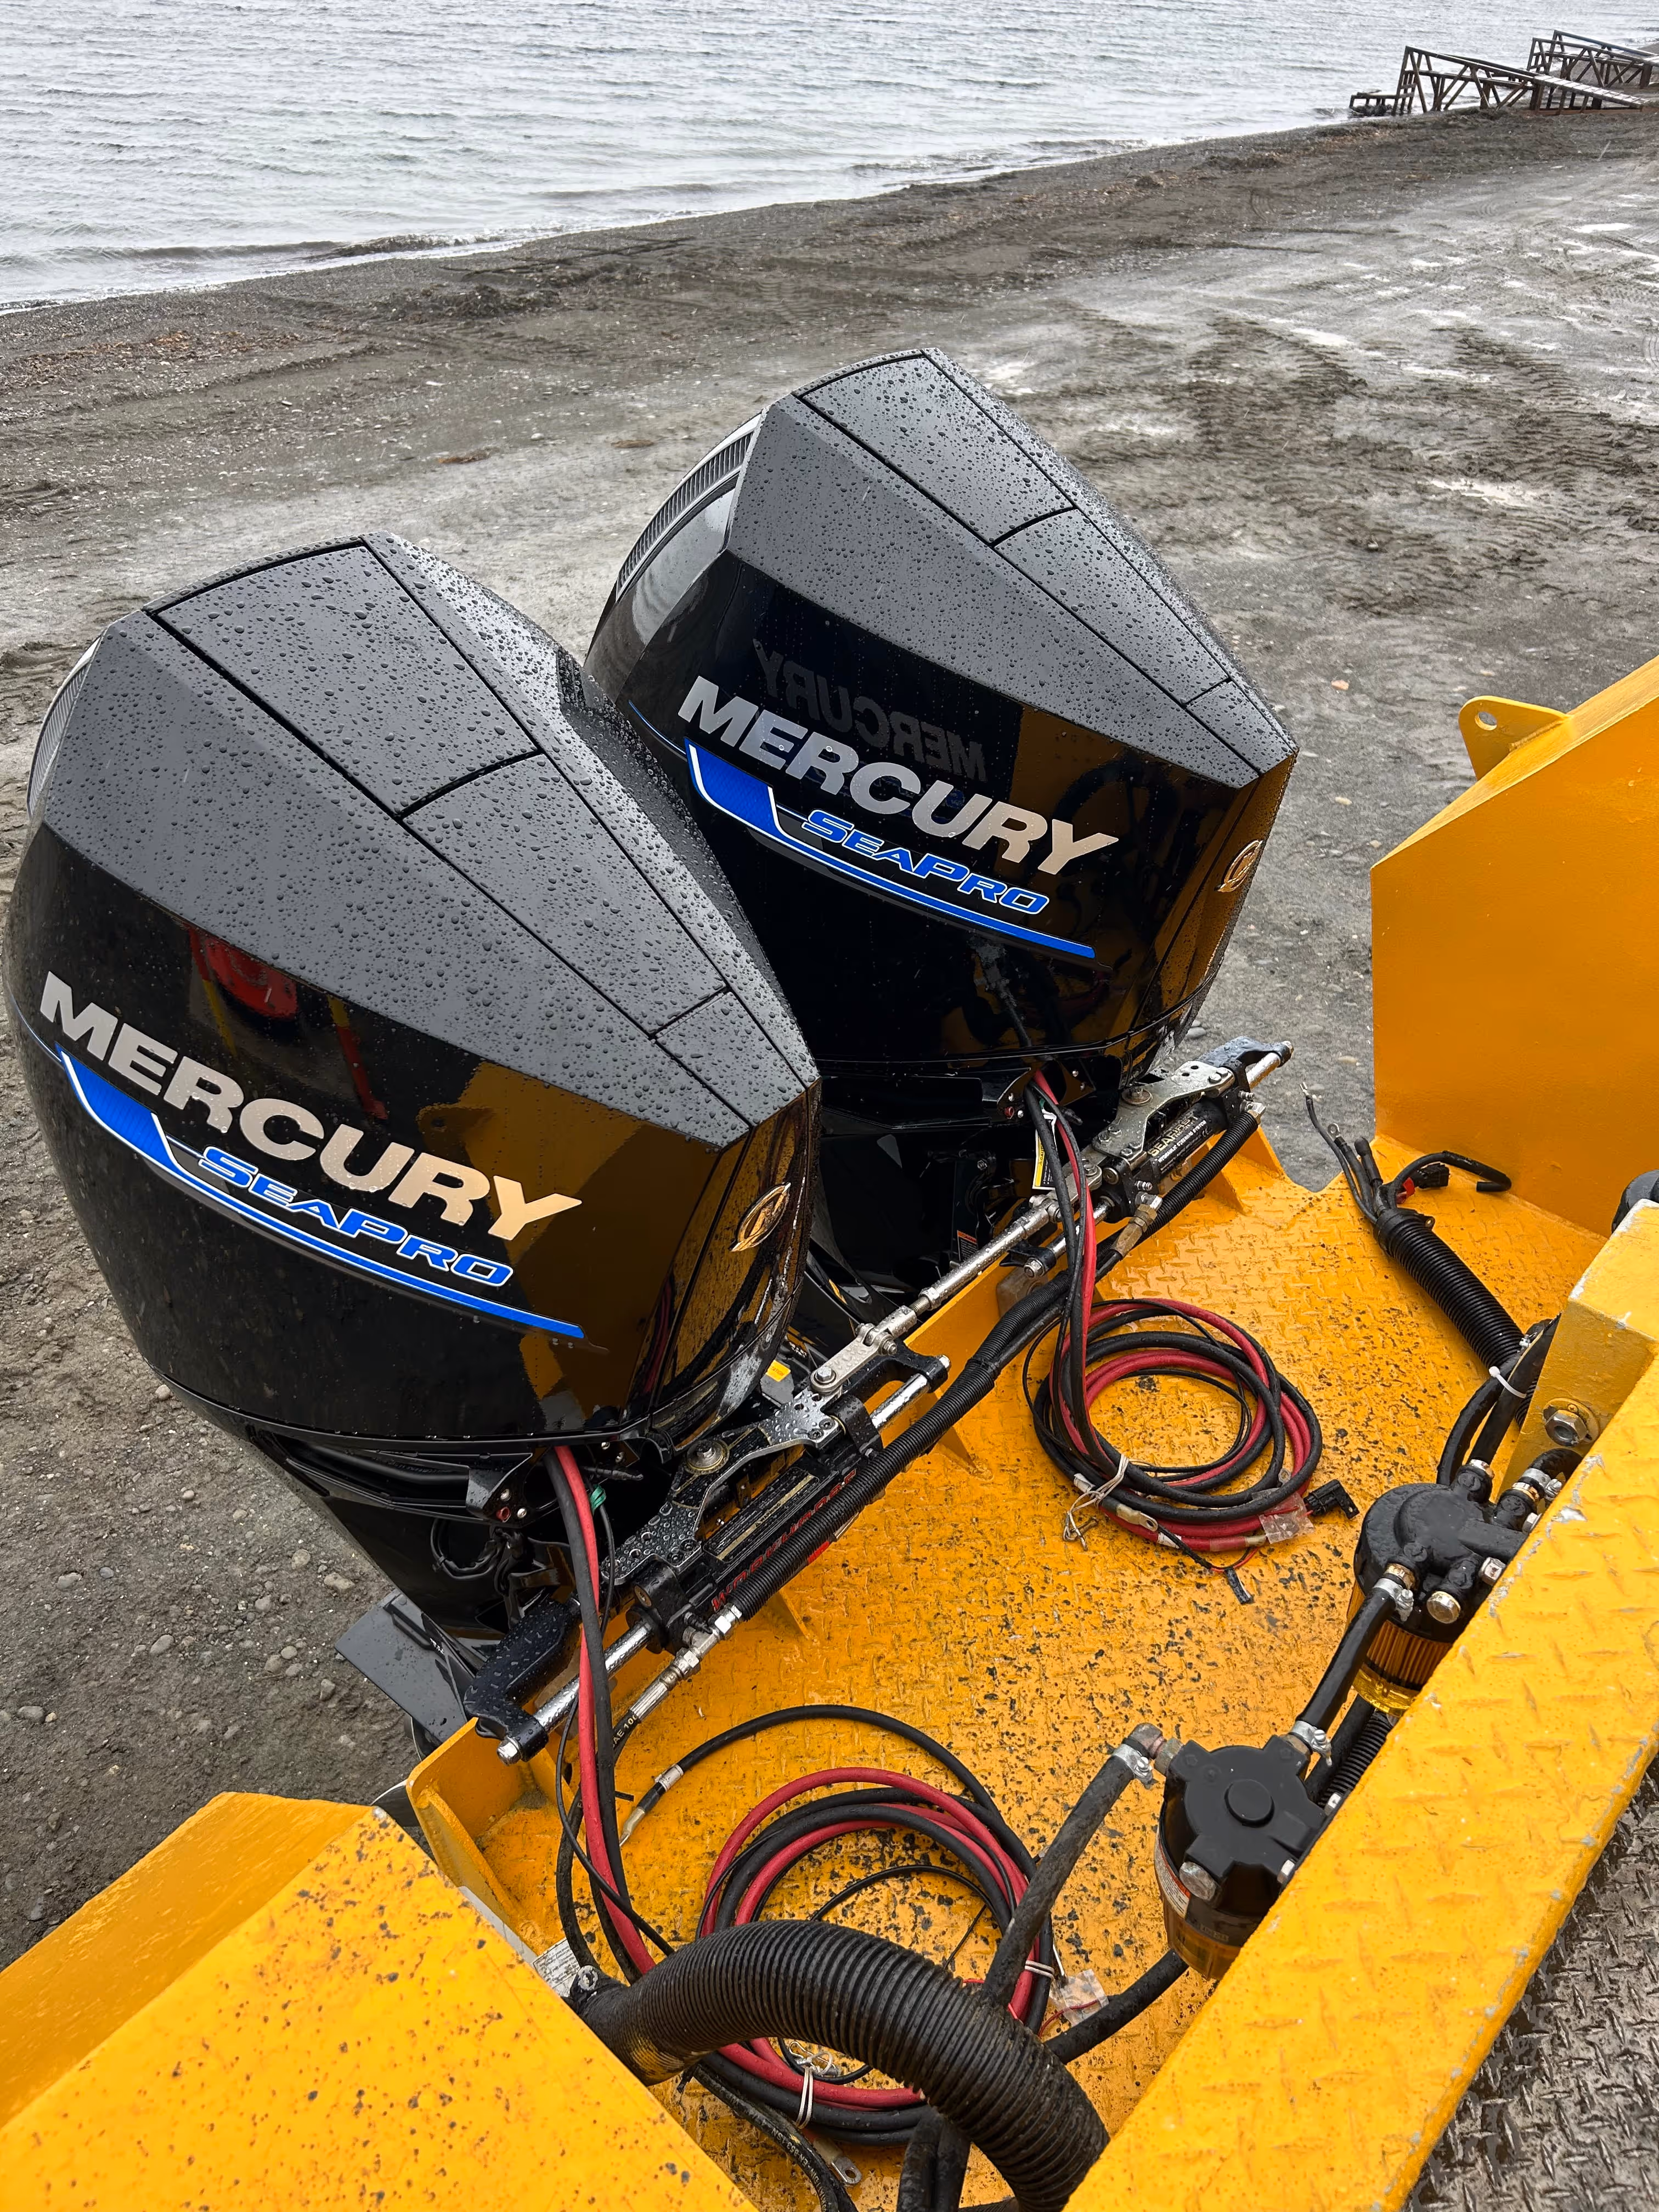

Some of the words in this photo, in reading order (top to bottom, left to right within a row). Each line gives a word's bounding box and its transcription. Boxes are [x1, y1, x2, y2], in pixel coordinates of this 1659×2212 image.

[678, 676, 1119, 875] MERCURY
[802, 809, 1049, 915] SEAPRO
[40, 971, 582, 1240] MERCURY
[198, 1145, 514, 1286] SEAPRO
[760, 1501, 781, 1523] WARNING
[613, 1729, 625, 1748] AE
